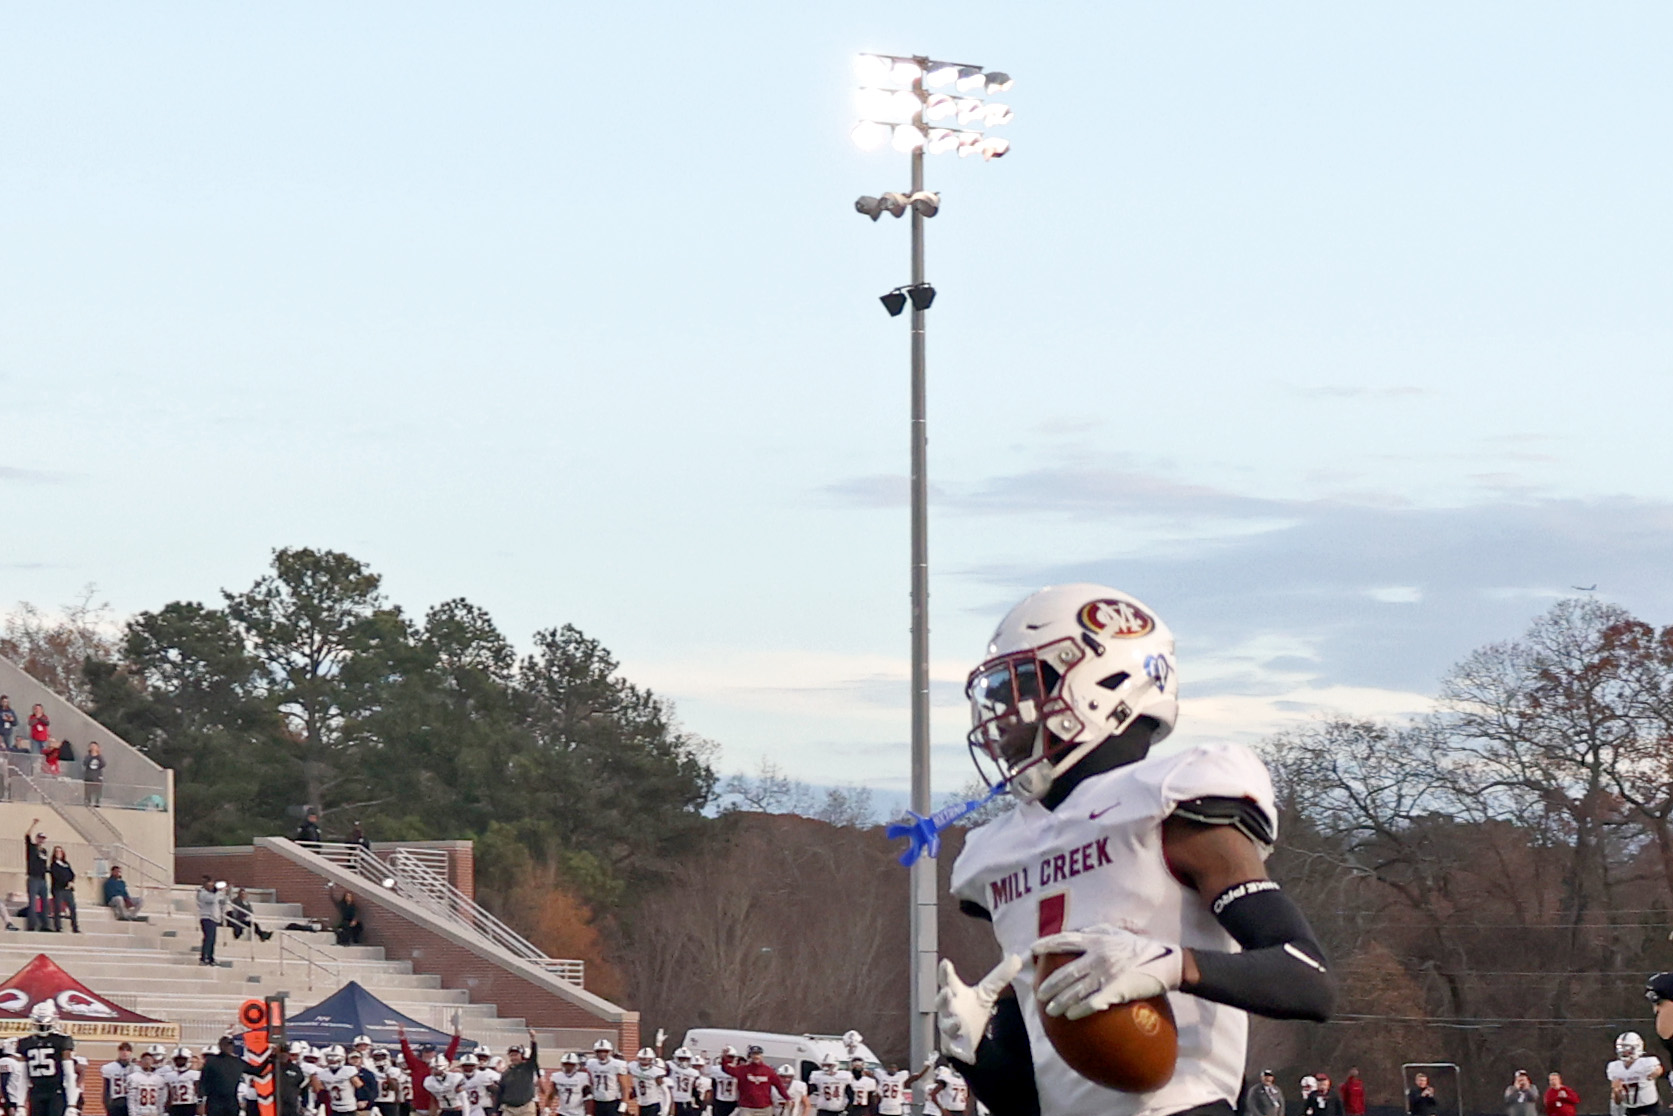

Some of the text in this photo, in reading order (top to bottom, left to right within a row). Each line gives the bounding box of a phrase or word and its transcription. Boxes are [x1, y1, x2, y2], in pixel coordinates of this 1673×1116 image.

[990, 836, 1113, 910] MILL CREEK
[1213, 885, 1246, 914] PRO
[132, 1025, 176, 1037] FOOTBALL
[27, 1048, 56, 1077] 25
[594, 1074, 608, 1091] 71
[882, 1083, 899, 1098] 26
[140, 1088, 156, 1106] 86
[564, 1088, 573, 1105] 7
[823, 1086, 840, 1101] 64
